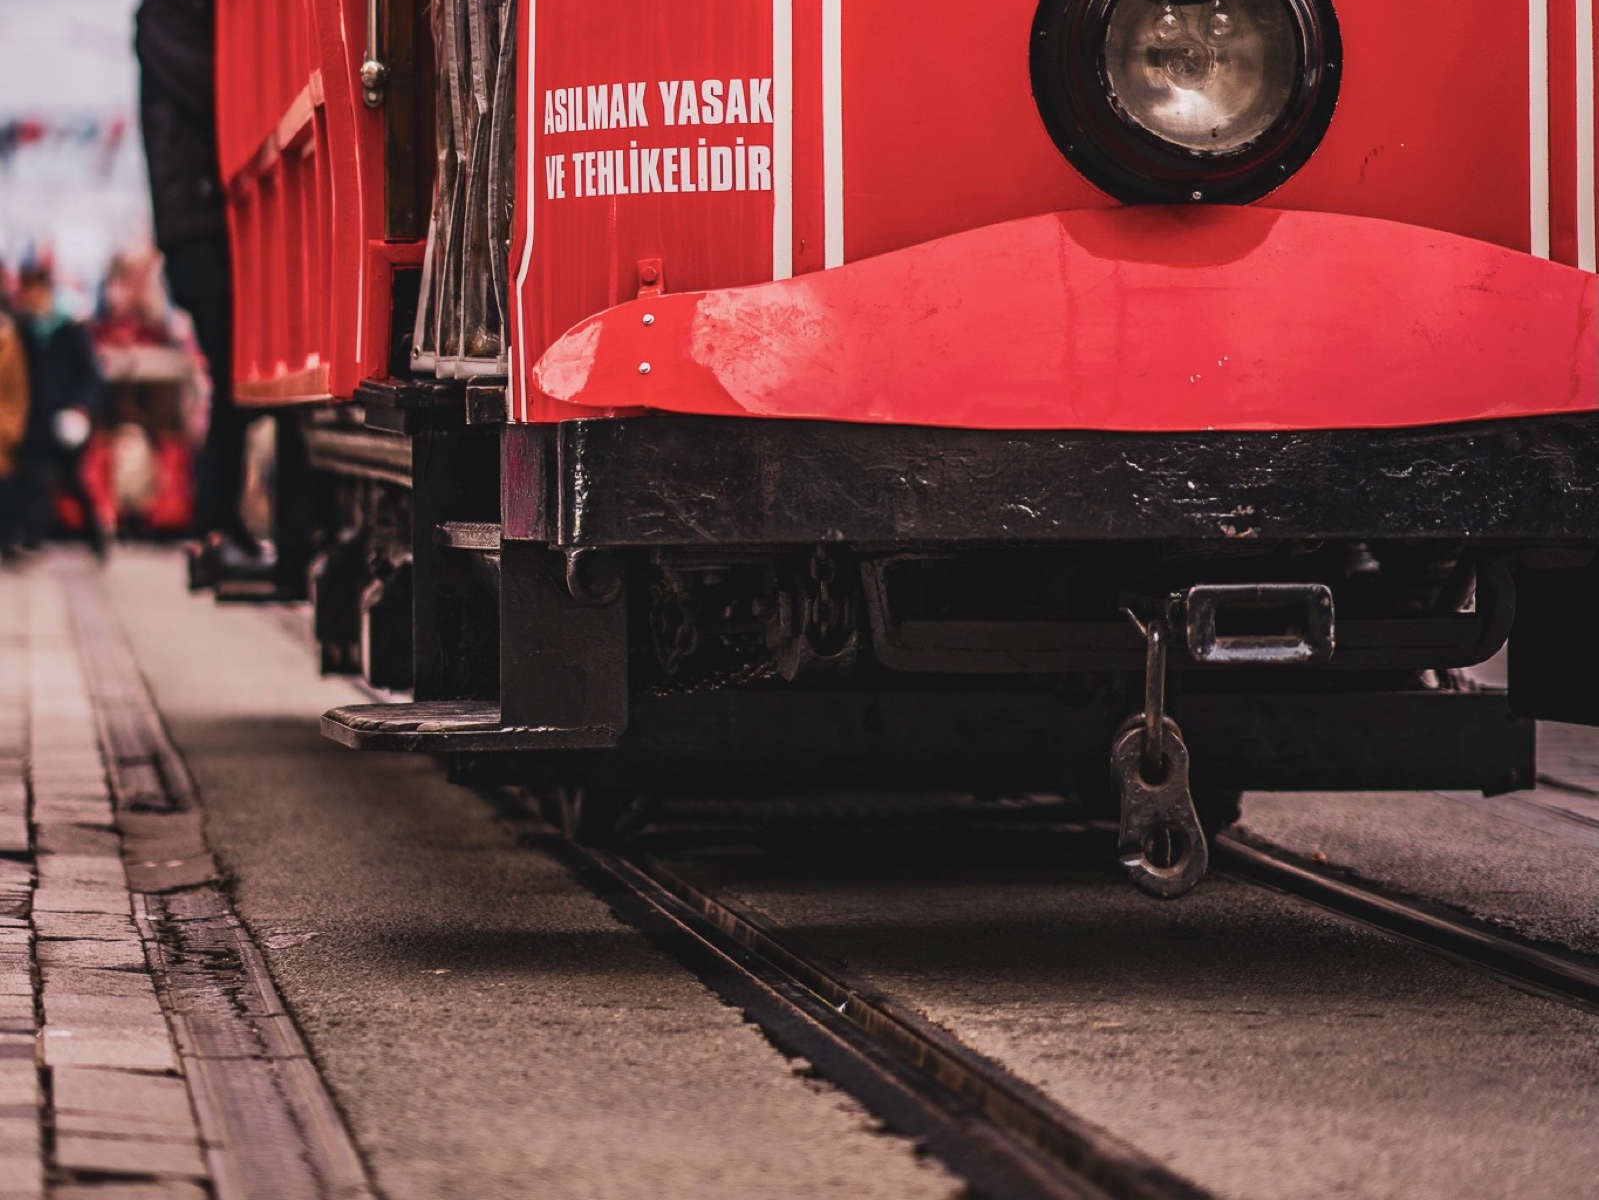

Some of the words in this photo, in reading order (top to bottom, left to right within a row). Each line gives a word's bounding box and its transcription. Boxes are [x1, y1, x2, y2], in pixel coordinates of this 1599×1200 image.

[544, 81, 649, 135] ASILMAK
[658, 78, 774, 126] YASAK
[545, 154, 566, 200] VE
[572, 136, 772, 198] TEHLİKELİDİR
